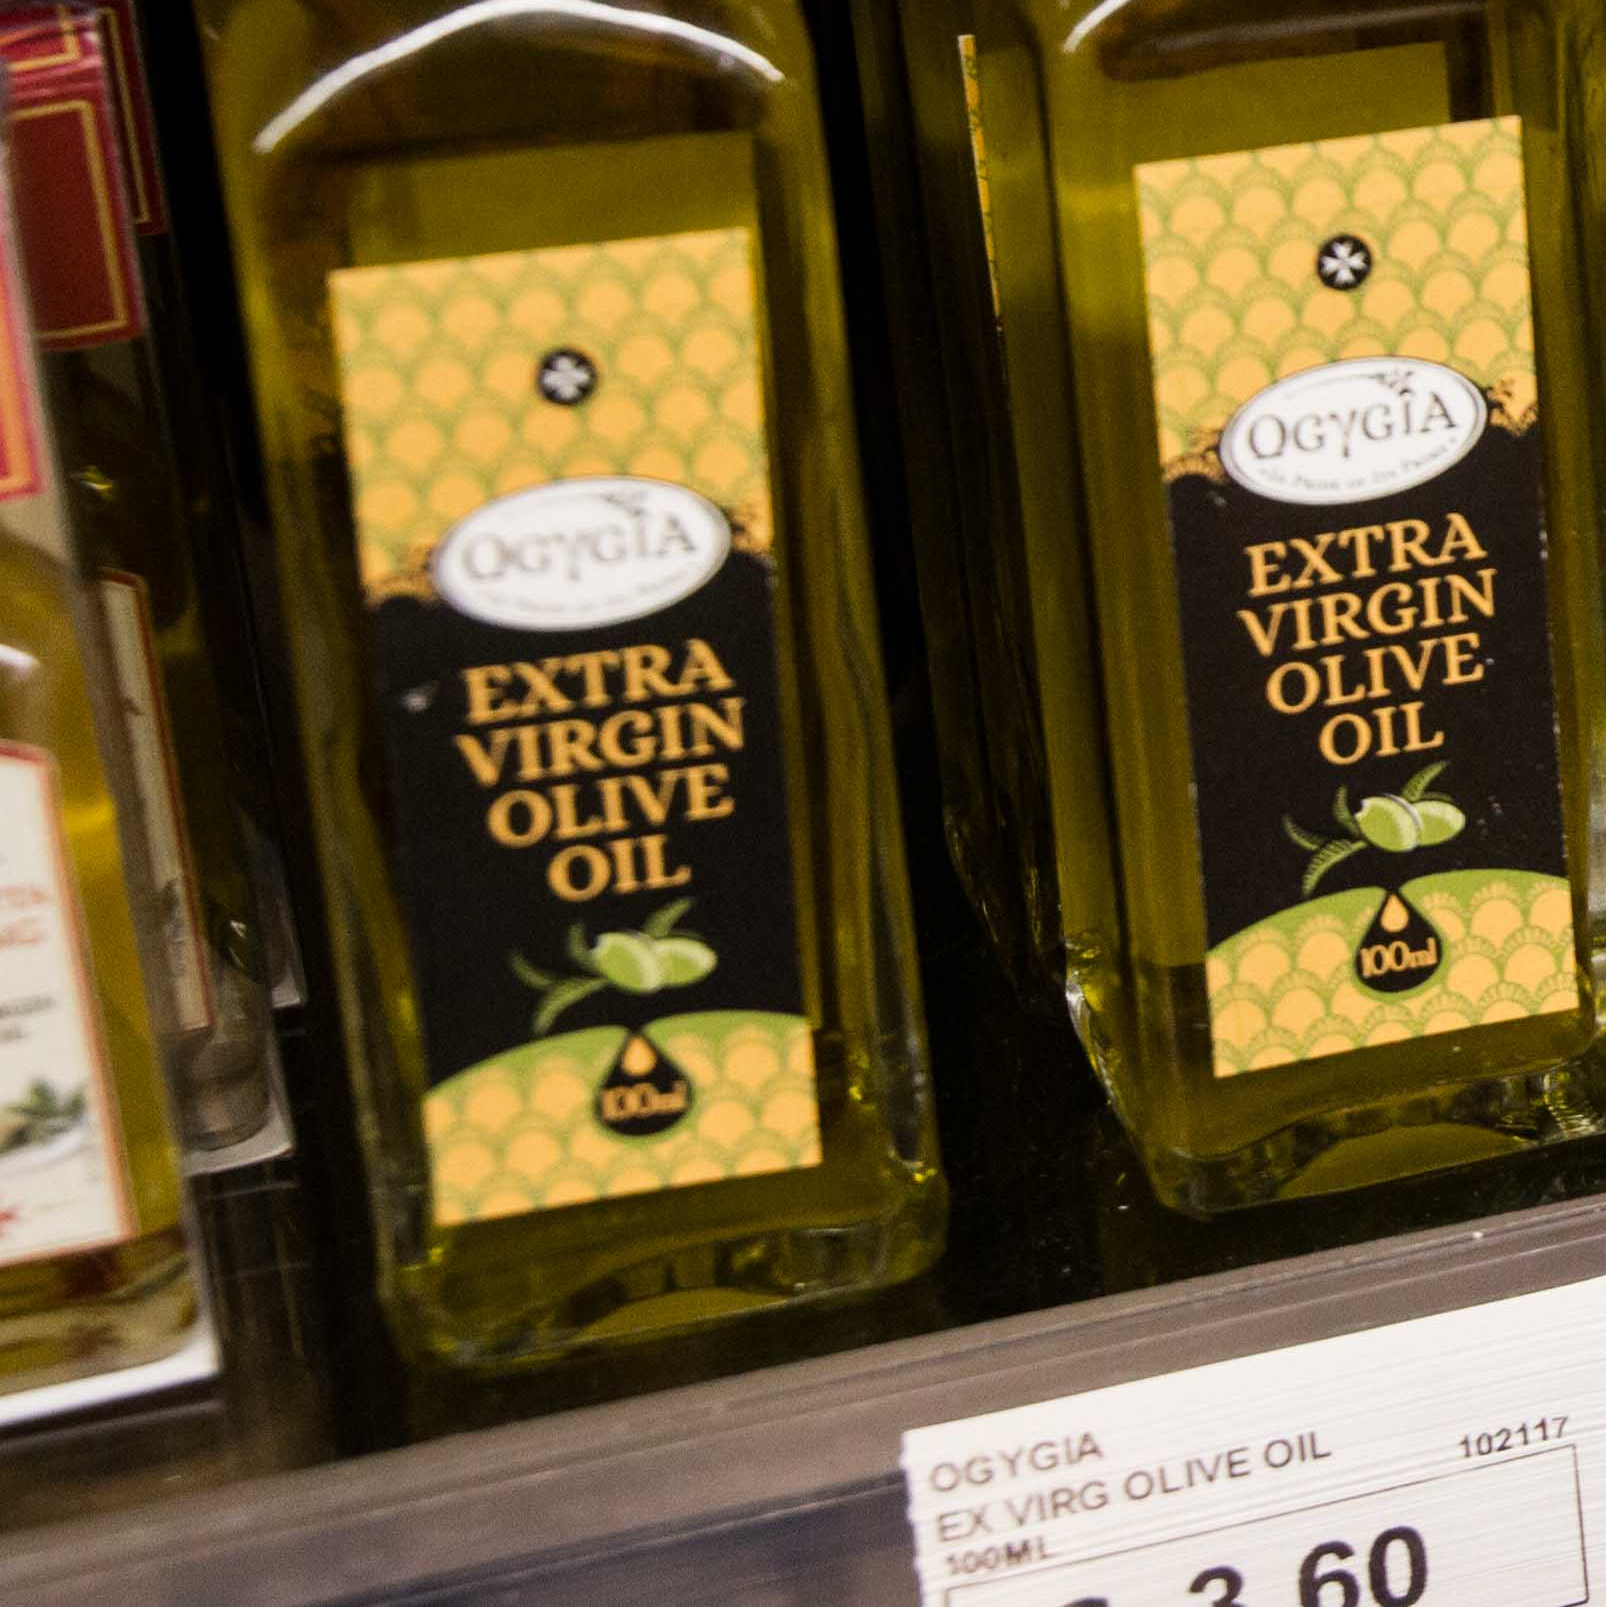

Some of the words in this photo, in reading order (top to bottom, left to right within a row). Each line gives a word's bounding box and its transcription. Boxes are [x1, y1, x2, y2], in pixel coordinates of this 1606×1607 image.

[1248, 392, 1458, 460] OGYGIA
[1244, 512, 1489, 597] EXTRA
[1237, 568, 1498, 658] VIRGIN
[461, 638, 737, 727] EXTRA
[1265, 631, 1485, 715] OLIVE
[453, 695, 748, 787] VIRGIN
[1319, 701, 1446, 765] OIL
[486, 763, 737, 848] OLIVE
[545, 834, 692, 903] OIL
[1359, 937, 1438, 979] 100ml
[930, 1432, 1103, 1492] OGYGIA
[1459, 1416, 1570, 1459] 102117
[937, 1504, 993, 1542] EX
[1004, 1481, 1109, 1526] VIRG
[1124, 1447, 1253, 1502] OLIVE
[1263, 1431, 1334, 1469] OIL
